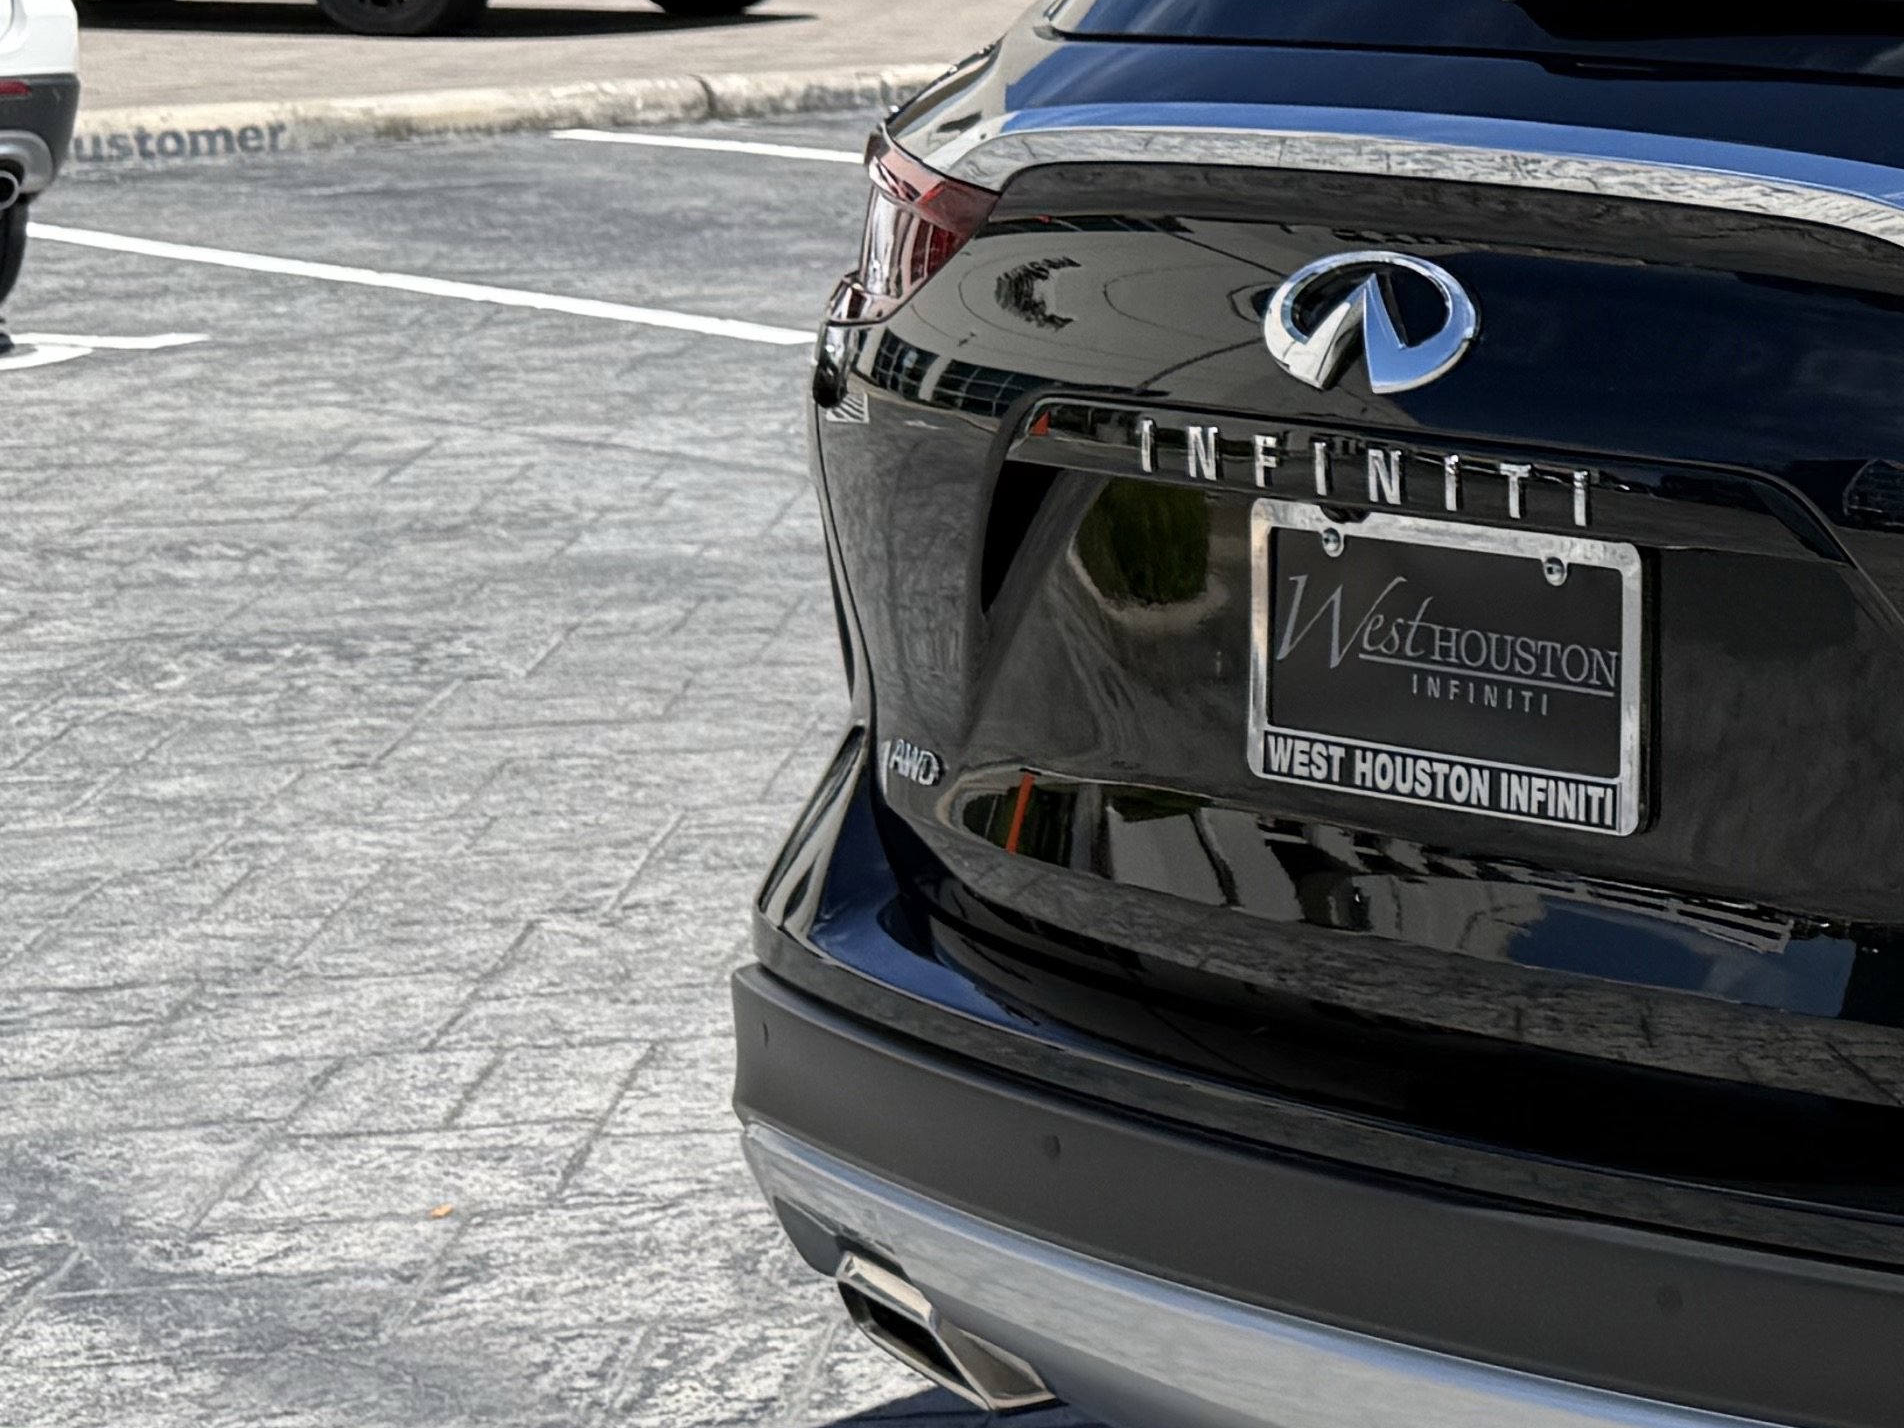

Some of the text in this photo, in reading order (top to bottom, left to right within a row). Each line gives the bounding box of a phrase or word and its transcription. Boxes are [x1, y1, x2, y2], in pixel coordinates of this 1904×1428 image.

[72, 122, 287, 163] ustomer
[1138, 418, 1591, 527] INFINITI
[1412, 673, 1548, 716] INFINITI
[888, 737, 941, 786] AWD
[1267, 734, 1614, 827] WEST HOUSTON INFINITI
